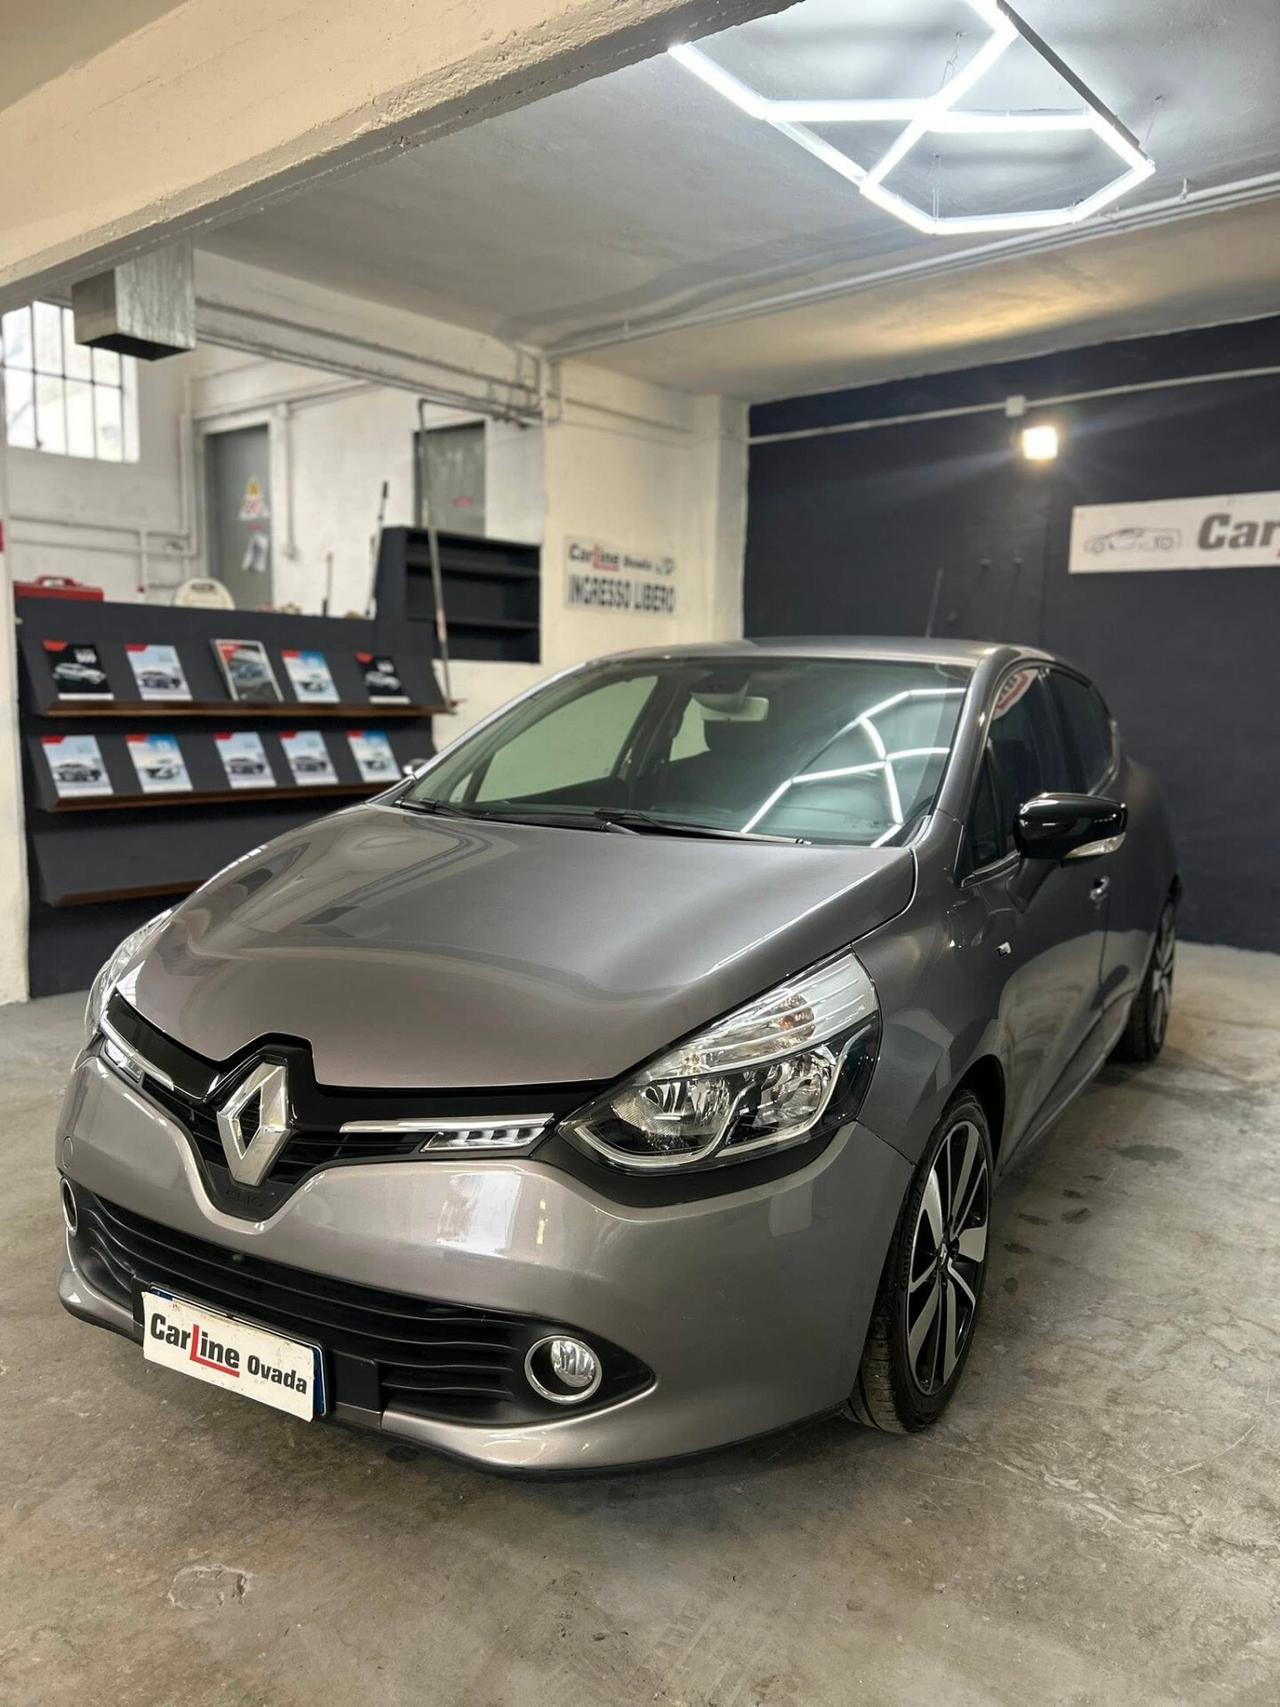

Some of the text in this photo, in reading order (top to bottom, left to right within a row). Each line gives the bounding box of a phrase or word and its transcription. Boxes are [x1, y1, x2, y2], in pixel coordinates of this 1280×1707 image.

[1197, 513, 1280, 553] Car
[150, 1312, 307, 1395] CarLine Ovada
